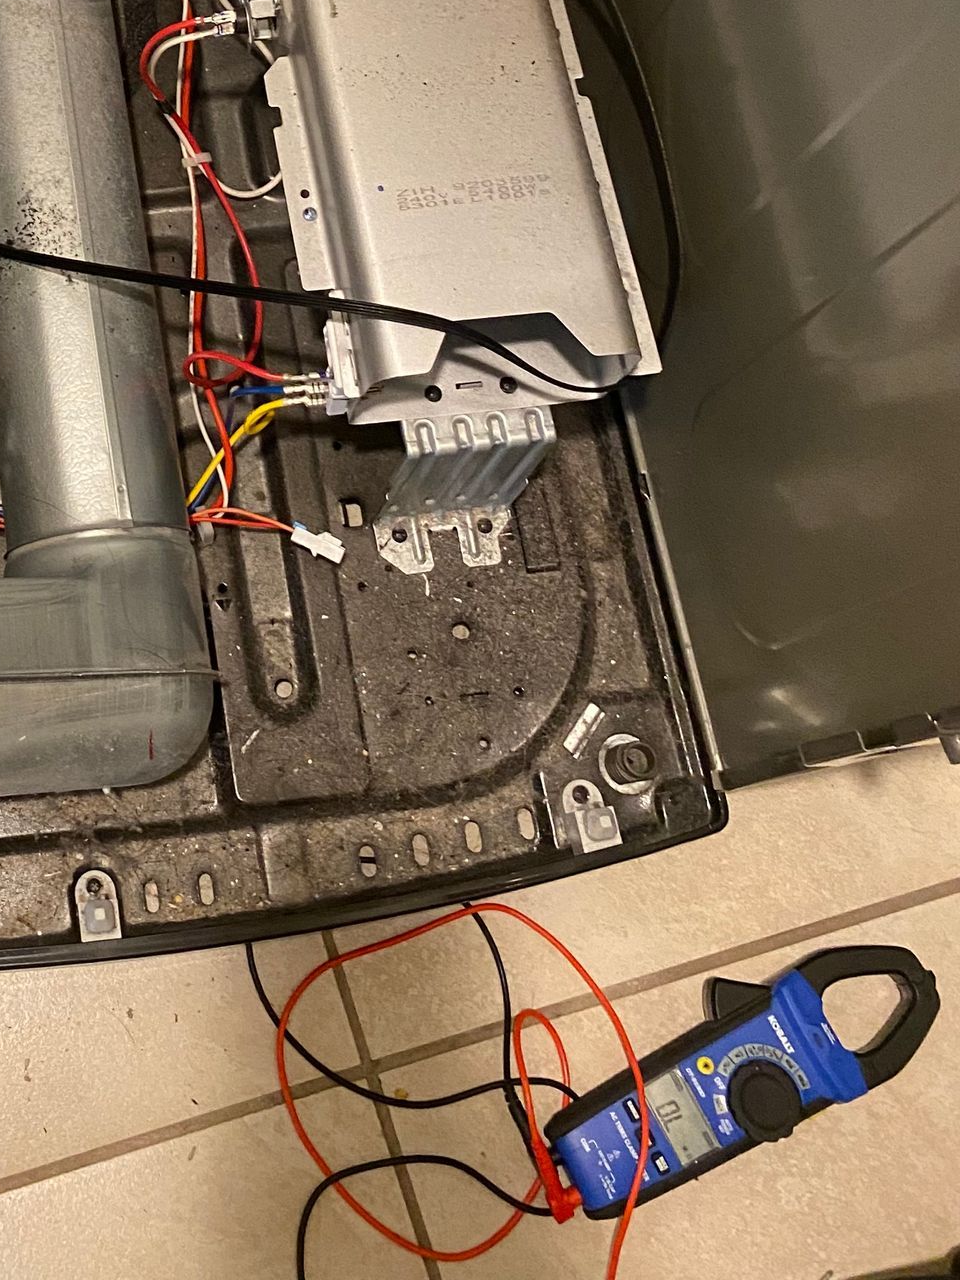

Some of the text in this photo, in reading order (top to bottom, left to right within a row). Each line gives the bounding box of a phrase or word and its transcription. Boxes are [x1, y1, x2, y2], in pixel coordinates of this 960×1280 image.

[766, 1013, 795, 1055] KOBALT
[713, 1075, 726, 1091] OFF
[608, 1110, 618, 1121] AC
[623, 1138, 639, 1160] CLAMP
